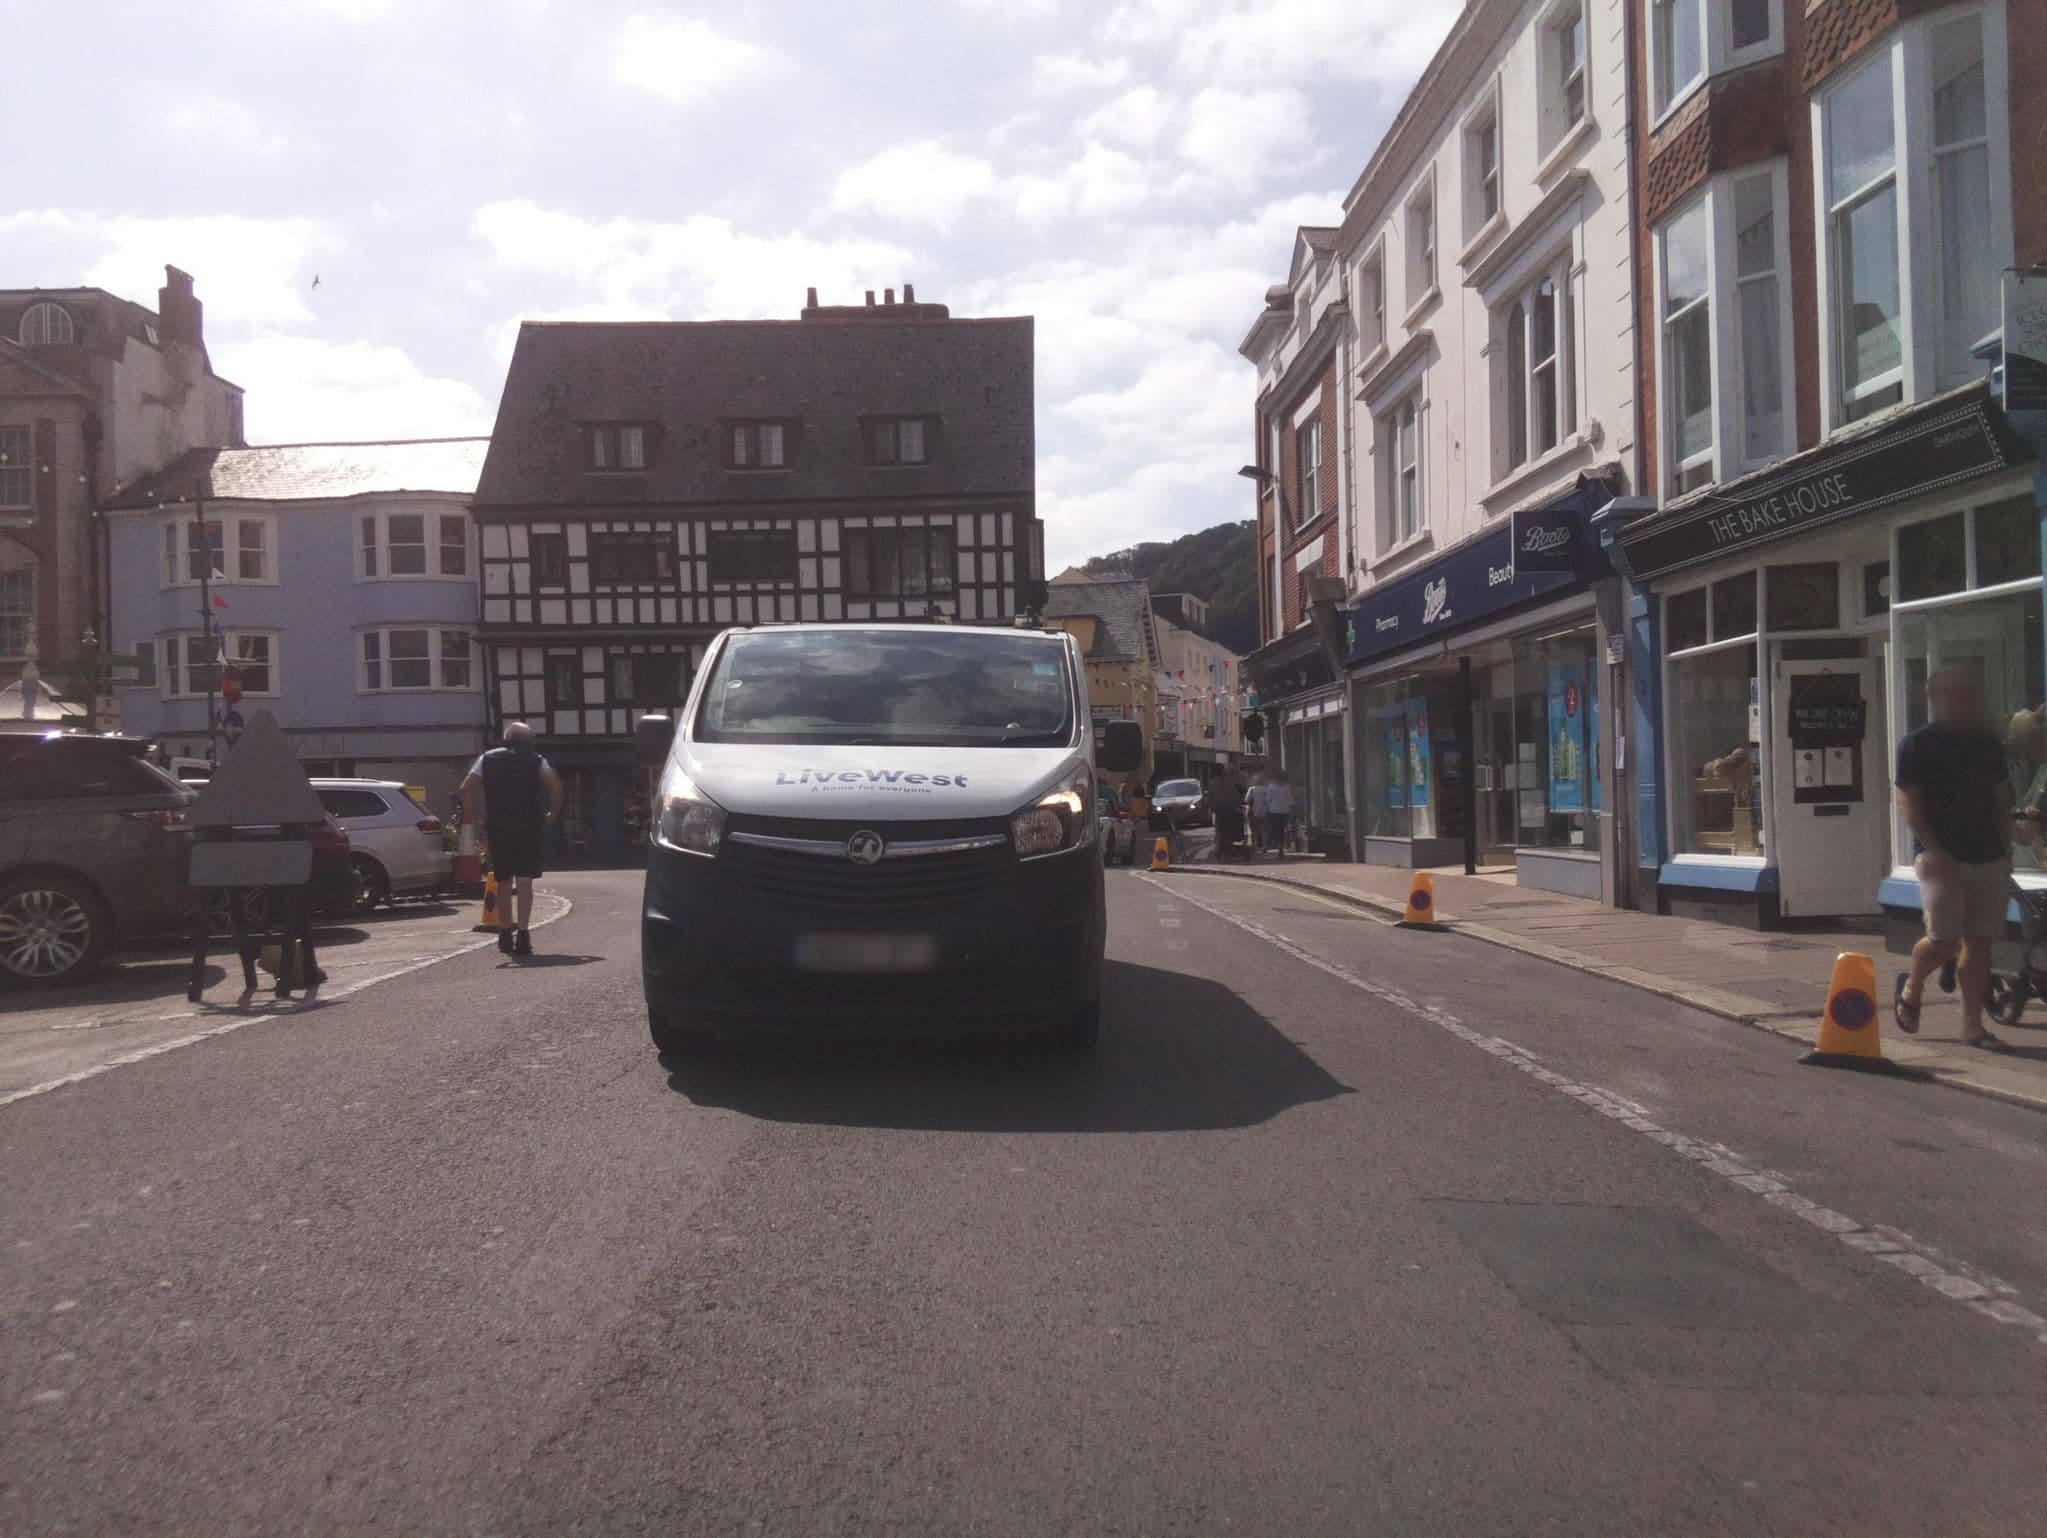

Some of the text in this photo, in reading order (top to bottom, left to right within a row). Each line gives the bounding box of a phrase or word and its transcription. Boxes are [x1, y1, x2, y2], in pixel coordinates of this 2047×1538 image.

[1708, 474, 1852, 543] THE BAKE HOUSE
[1521, 526, 1571, 551] Boots
[1422, 576, 1447, 624] Boots
[1376, 615, 1399, 632] Pharmacy
[776, 768, 968, 788] LiveWest
